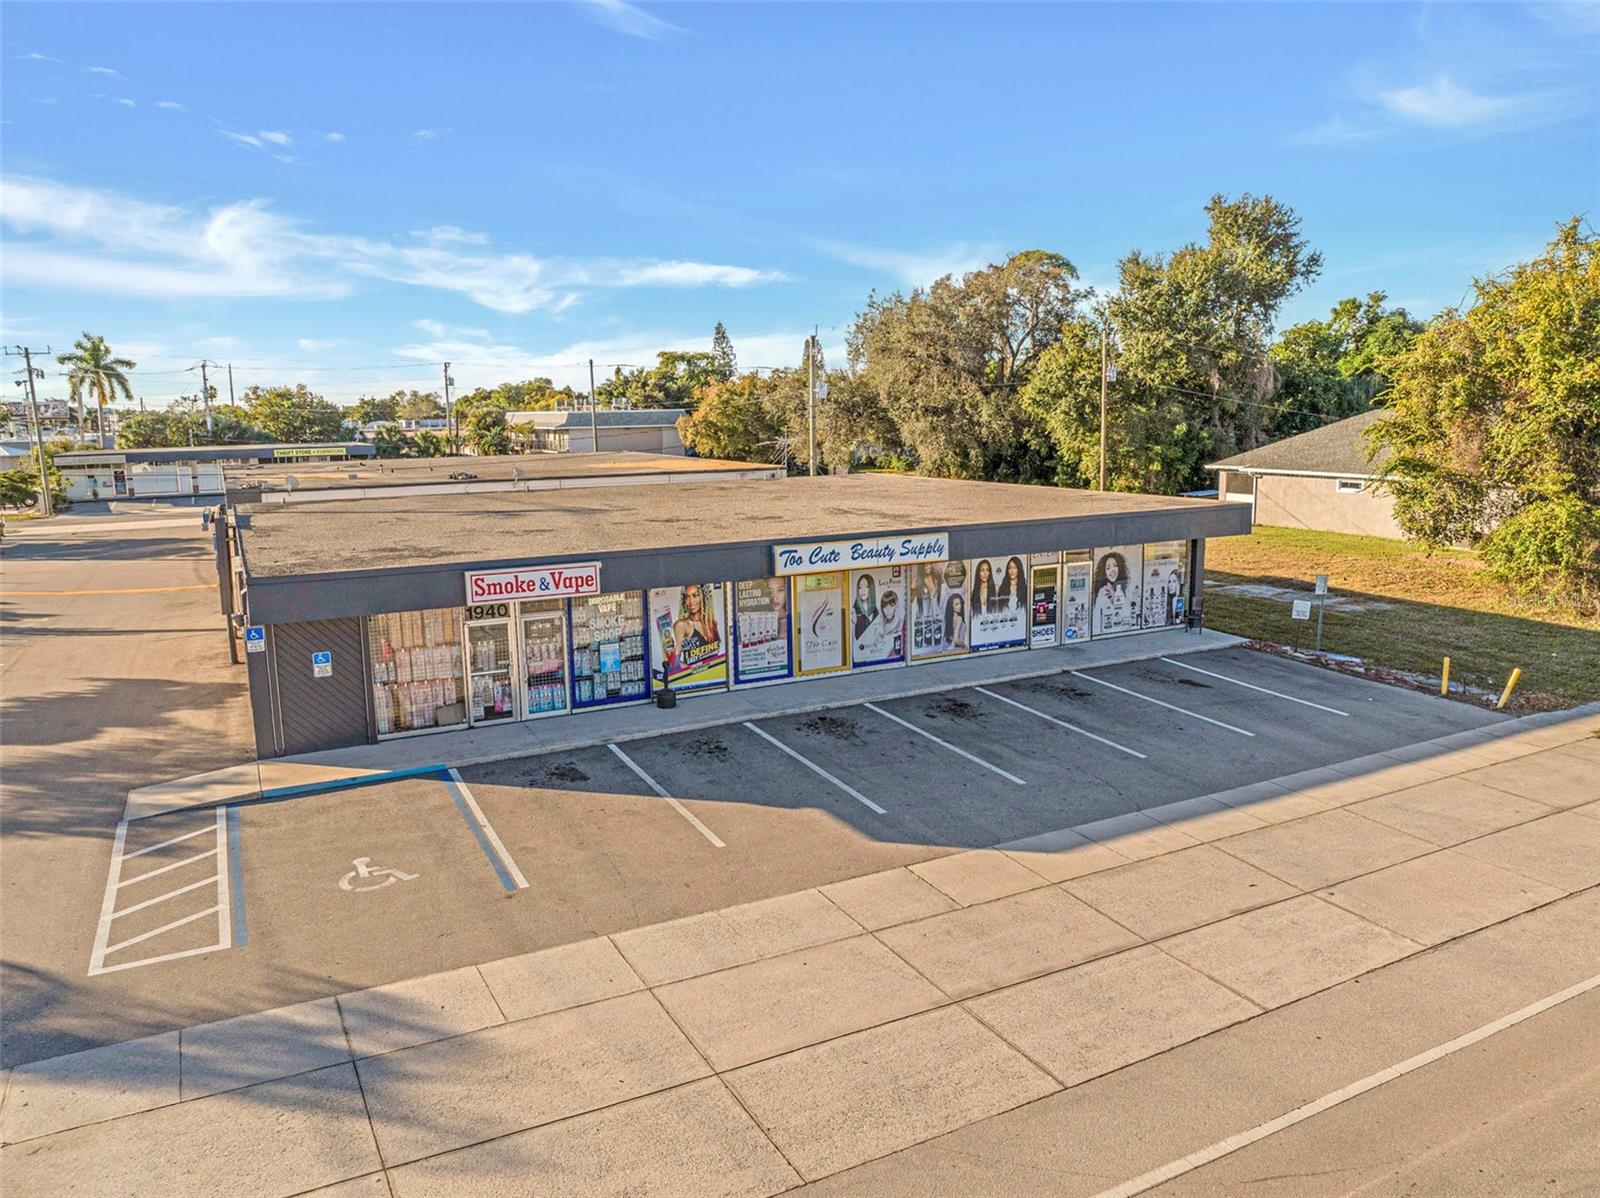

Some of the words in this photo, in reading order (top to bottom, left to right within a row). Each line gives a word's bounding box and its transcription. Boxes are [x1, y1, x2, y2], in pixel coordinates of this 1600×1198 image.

[779, 549, 804, 568] Too
[809, 546, 841, 565] Cute
[850, 542, 896, 562] Beauty
[899, 538, 945, 560] Supply
[474, 575, 536, 597] Smoke
[538, 577, 551, 591] &
[549, 571, 595, 593] Vape
[738, 581, 753, 590] DEEP
[739, 589, 762, 599] LASTING
[598, 603, 617, 613] VAPE
[739, 597, 770, 607] HYDRATION
[466, 604, 508, 620] 1940
[589, 614, 625, 630] SMOKE
[594, 628, 622, 642] SHOP
[1031, 627, 1055, 637] SHOES
[690, 640, 721, 657] DEFINE
